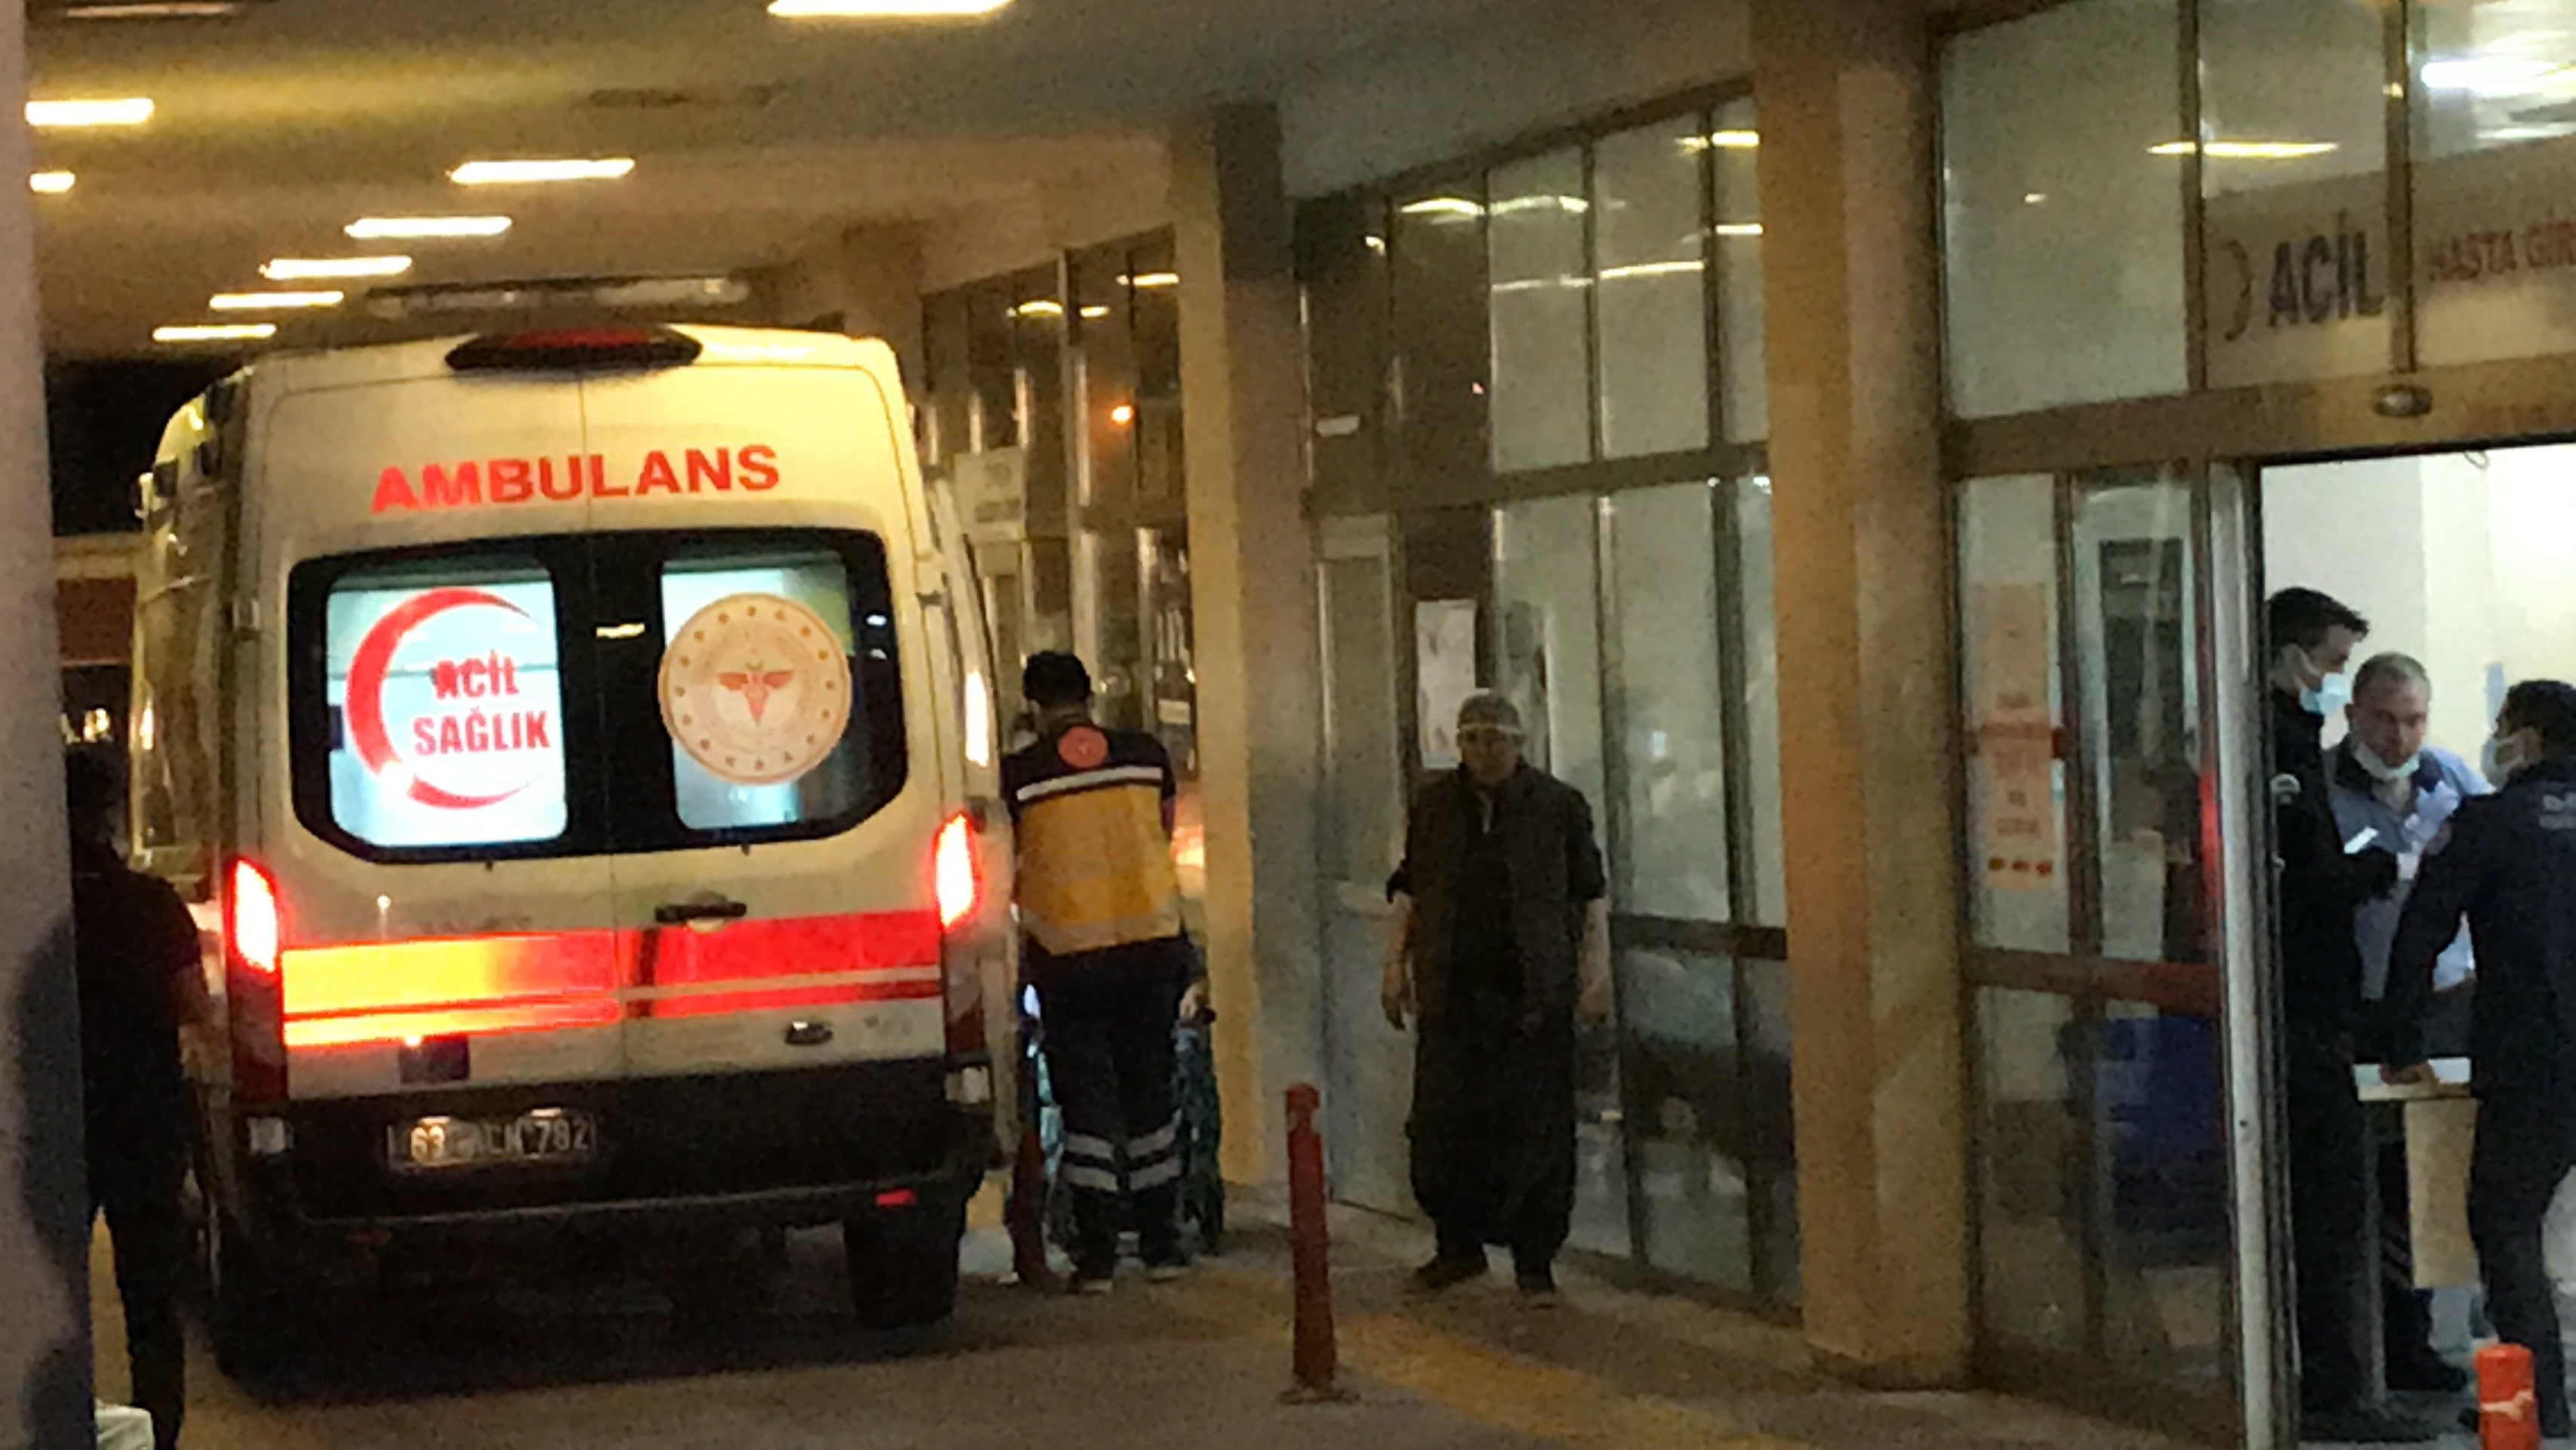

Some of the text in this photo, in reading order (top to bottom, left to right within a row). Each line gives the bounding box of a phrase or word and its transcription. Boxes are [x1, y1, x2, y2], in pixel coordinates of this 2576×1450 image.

[371, 443, 781, 514] AMBULANS
[412, 705, 550, 757] SAĞLIK
[410, 1125, 447, 1161] 63
